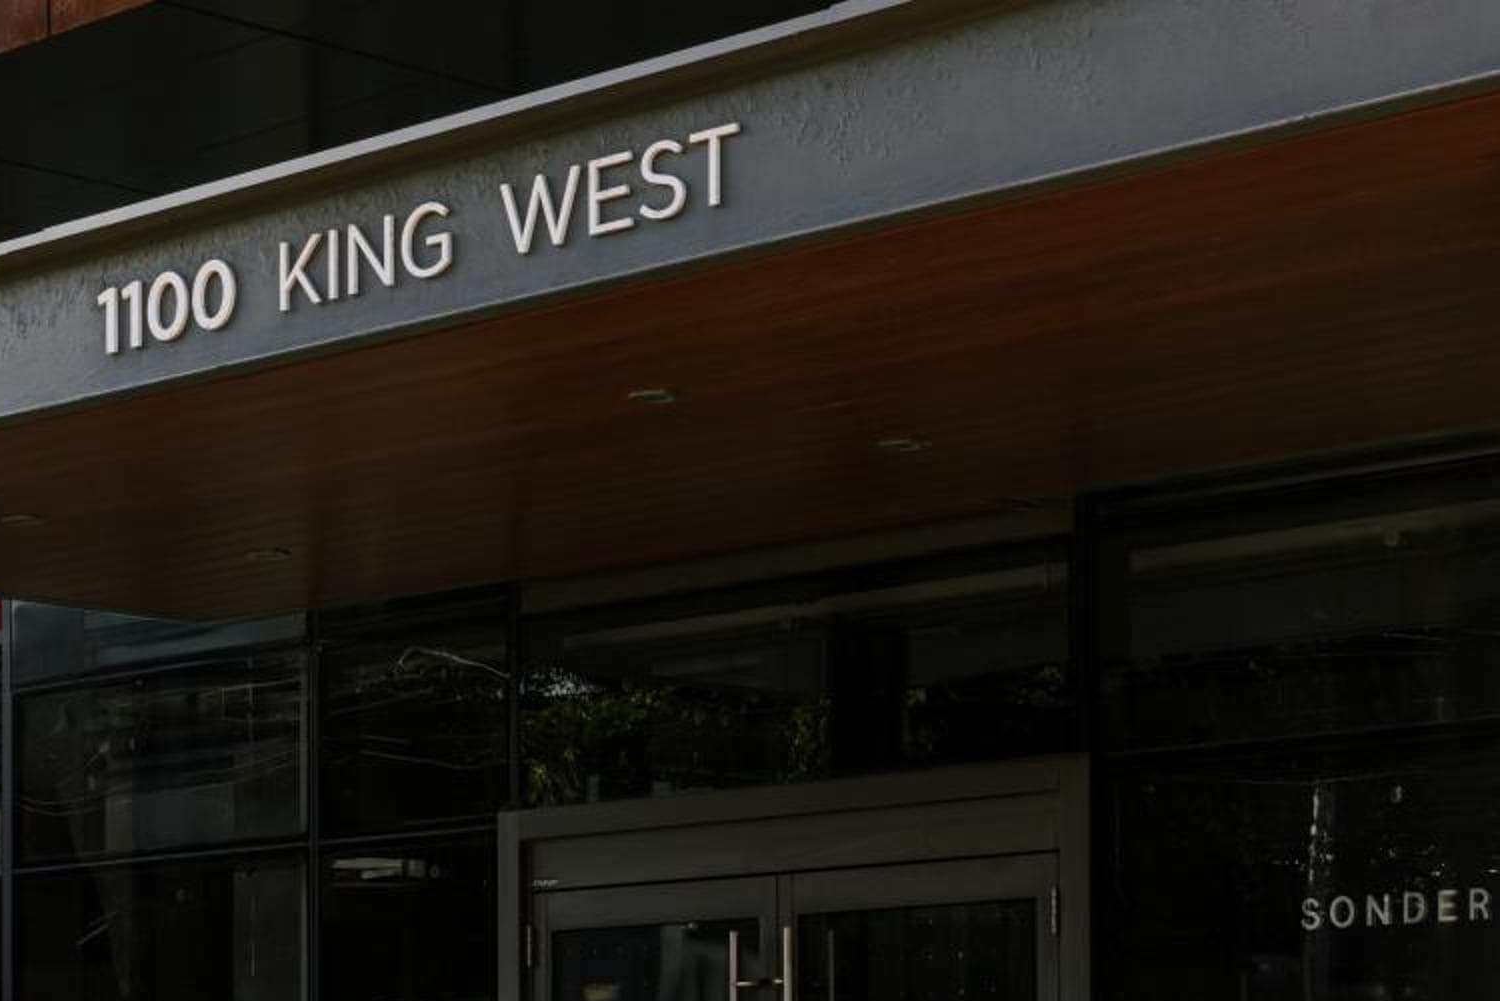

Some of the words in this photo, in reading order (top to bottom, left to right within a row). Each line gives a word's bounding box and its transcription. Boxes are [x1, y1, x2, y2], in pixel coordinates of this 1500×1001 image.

[97, 258, 237, 355] 1100
[278, 201, 455, 313] KING
[500, 121, 741, 256] WEST
[1300, 887, 1492, 931] SONDER
